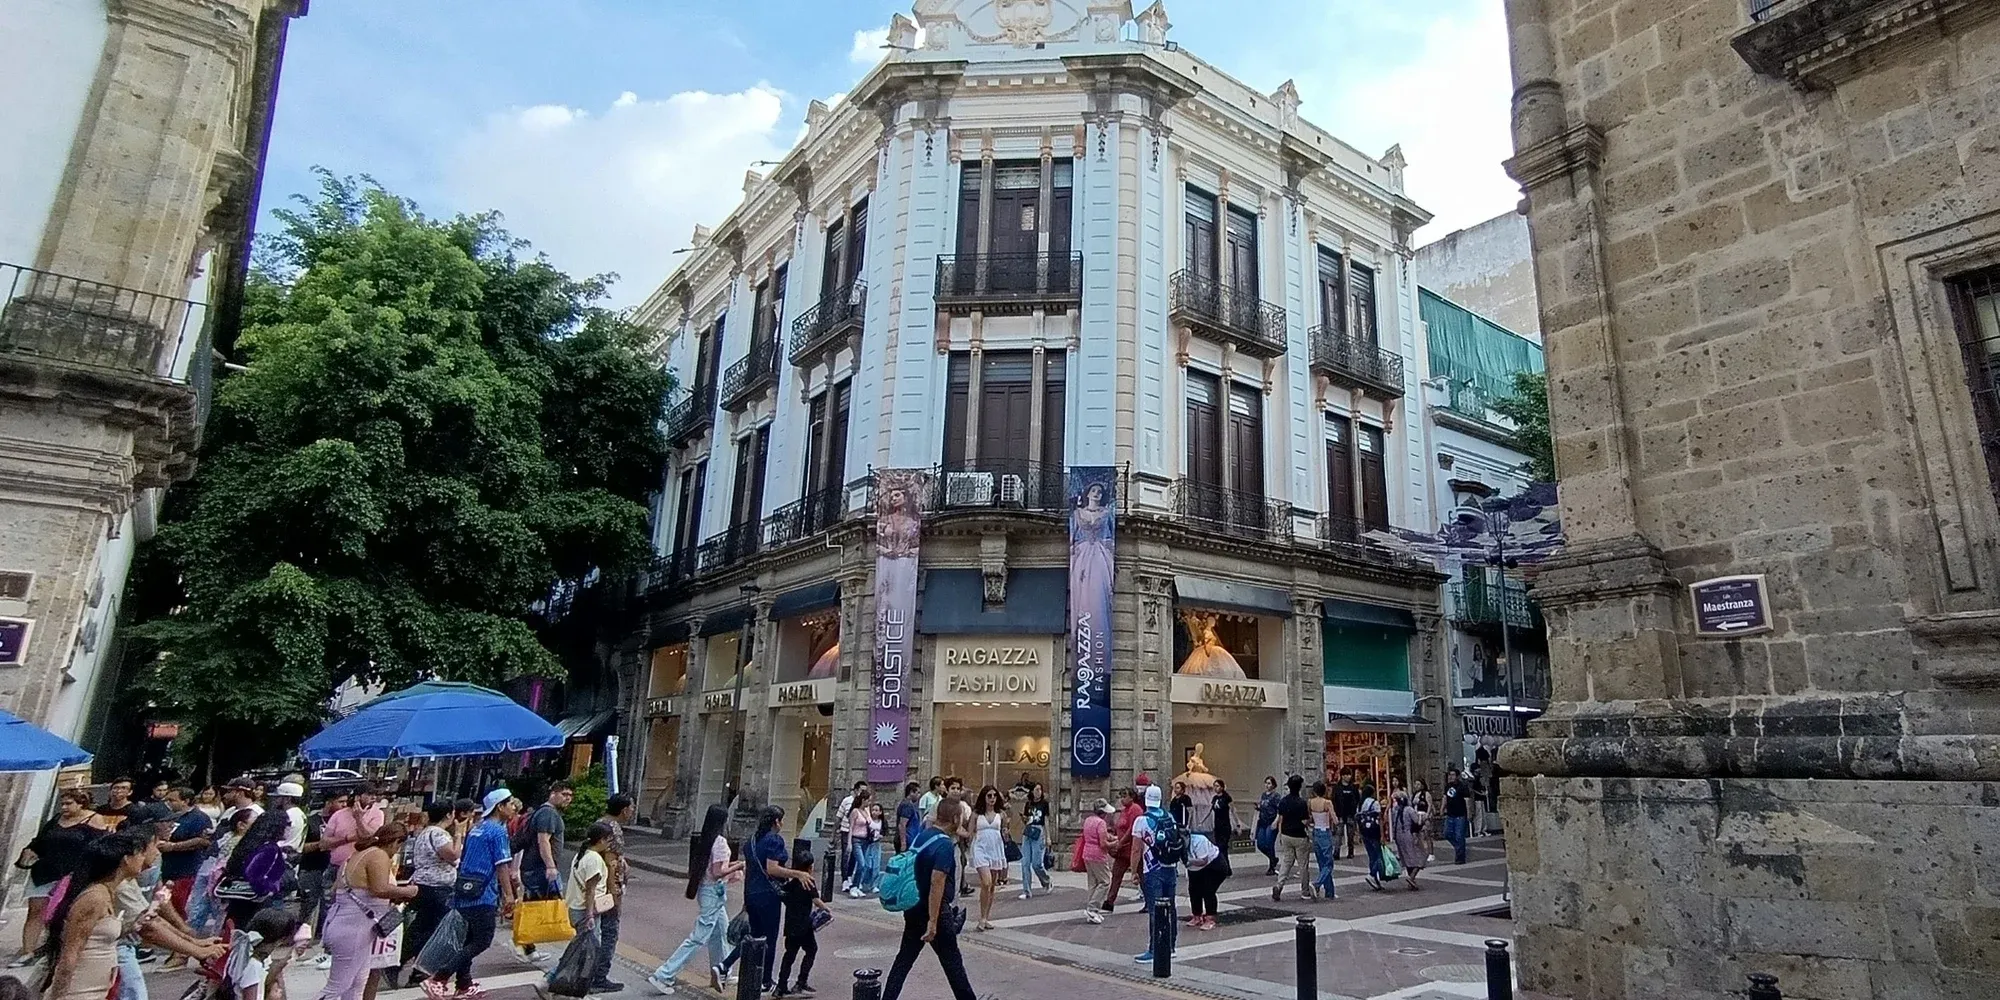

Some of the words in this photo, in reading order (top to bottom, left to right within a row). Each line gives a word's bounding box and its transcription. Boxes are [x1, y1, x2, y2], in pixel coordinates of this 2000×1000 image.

[1703, 599, 1754, 613] Maestranza
[882, 609, 905, 709] SOLSTICE
[945, 647, 1039, 666] RAGAZZA
[1077, 611, 1094, 709] RAGAZZA
[1095, 631, 1104, 691] FASHION
[947, 674, 1037, 692] FASHION
[1202, 683, 1267, 703] RAGAZZA
